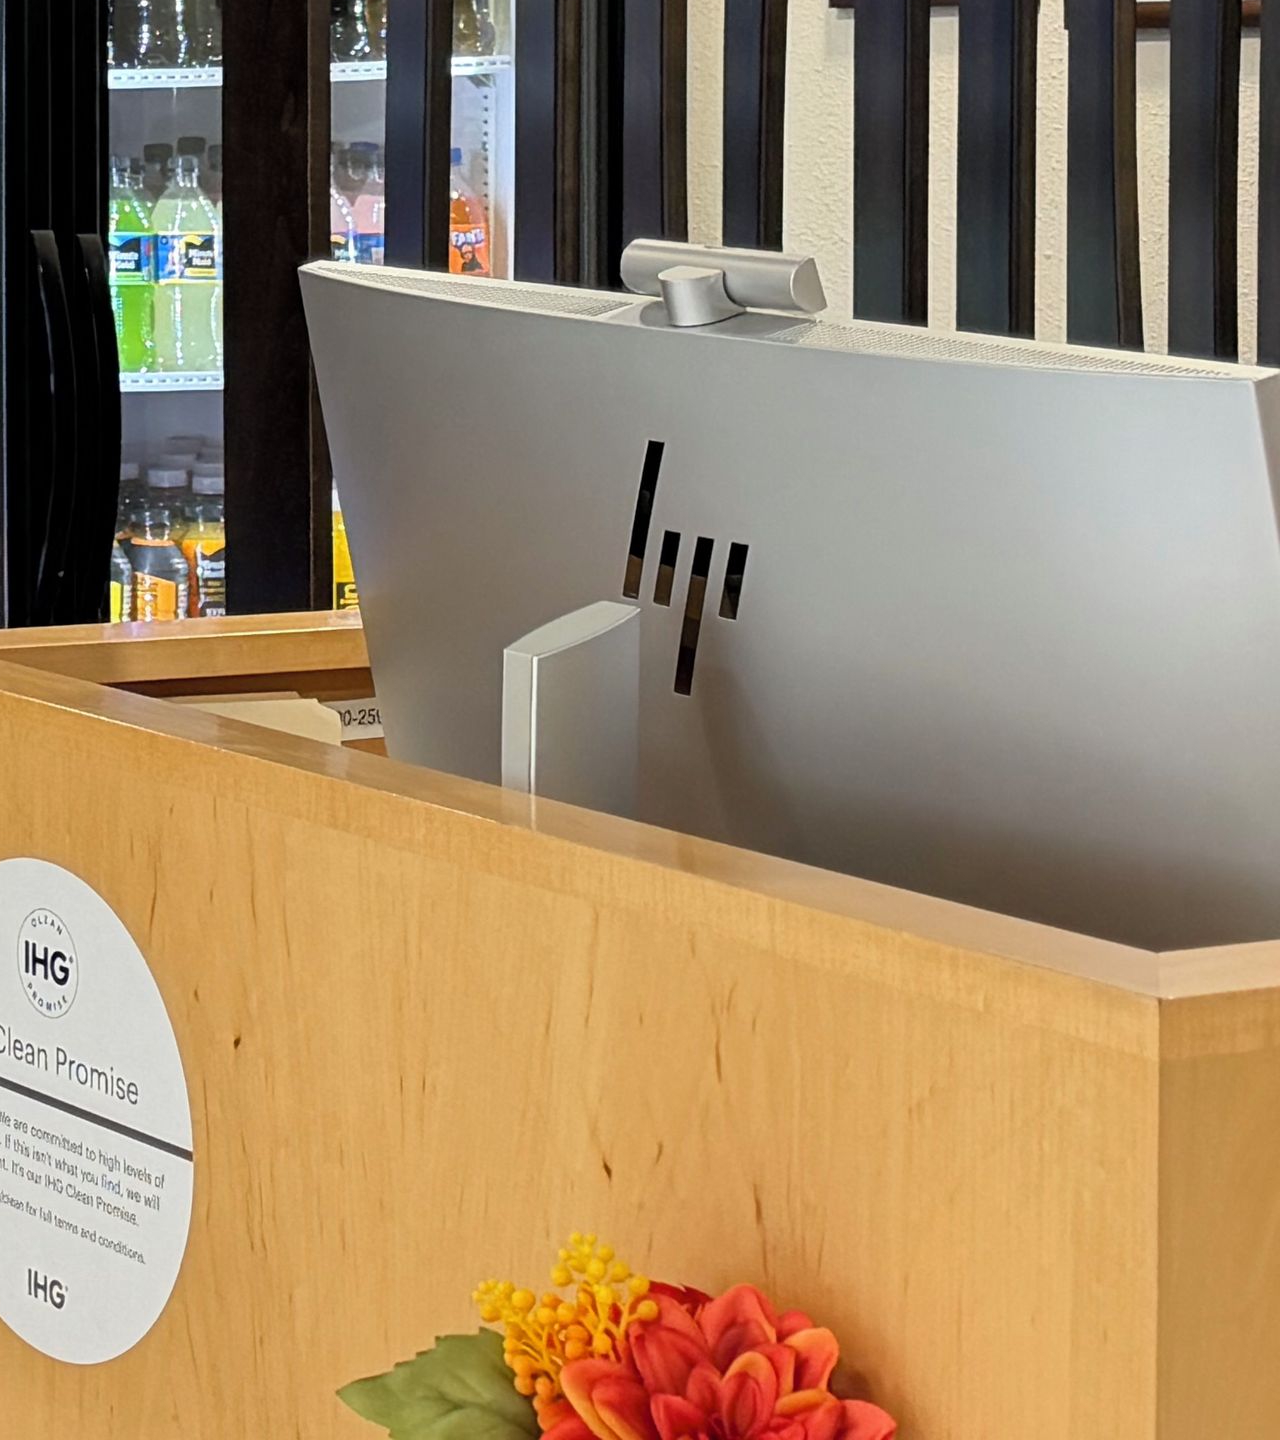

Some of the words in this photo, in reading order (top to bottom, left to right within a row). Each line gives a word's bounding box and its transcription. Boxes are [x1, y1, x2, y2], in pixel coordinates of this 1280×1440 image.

[31, 915, 62, 935] CLEAN
[27, 982, 68, 1012] PROMISE
[56, 1047, 139, 1105] Promise
[13, 1119, 28, 1134] are
[30, 1126, 83, 1156] committed
[86, 1146, 97, 1162] to
[99, 1149, 120, 1172] high
[123, 1159, 152, 1185] levels
[154, 1174, 165, 1189] of
[13, 1138, 30, 1158] this
[54, 1157, 78, 1178] what
[80, 1169, 99, 1186] you
[126, 1187, 141, 1203] we
[144, 1194, 160, 1211] will
[26, 1169, 42, 1185] our
[44, 1174, 64, 1194] IHG
[66, 1183, 94, 1207] Clean
[27, 1267, 66, 1310] IHG
